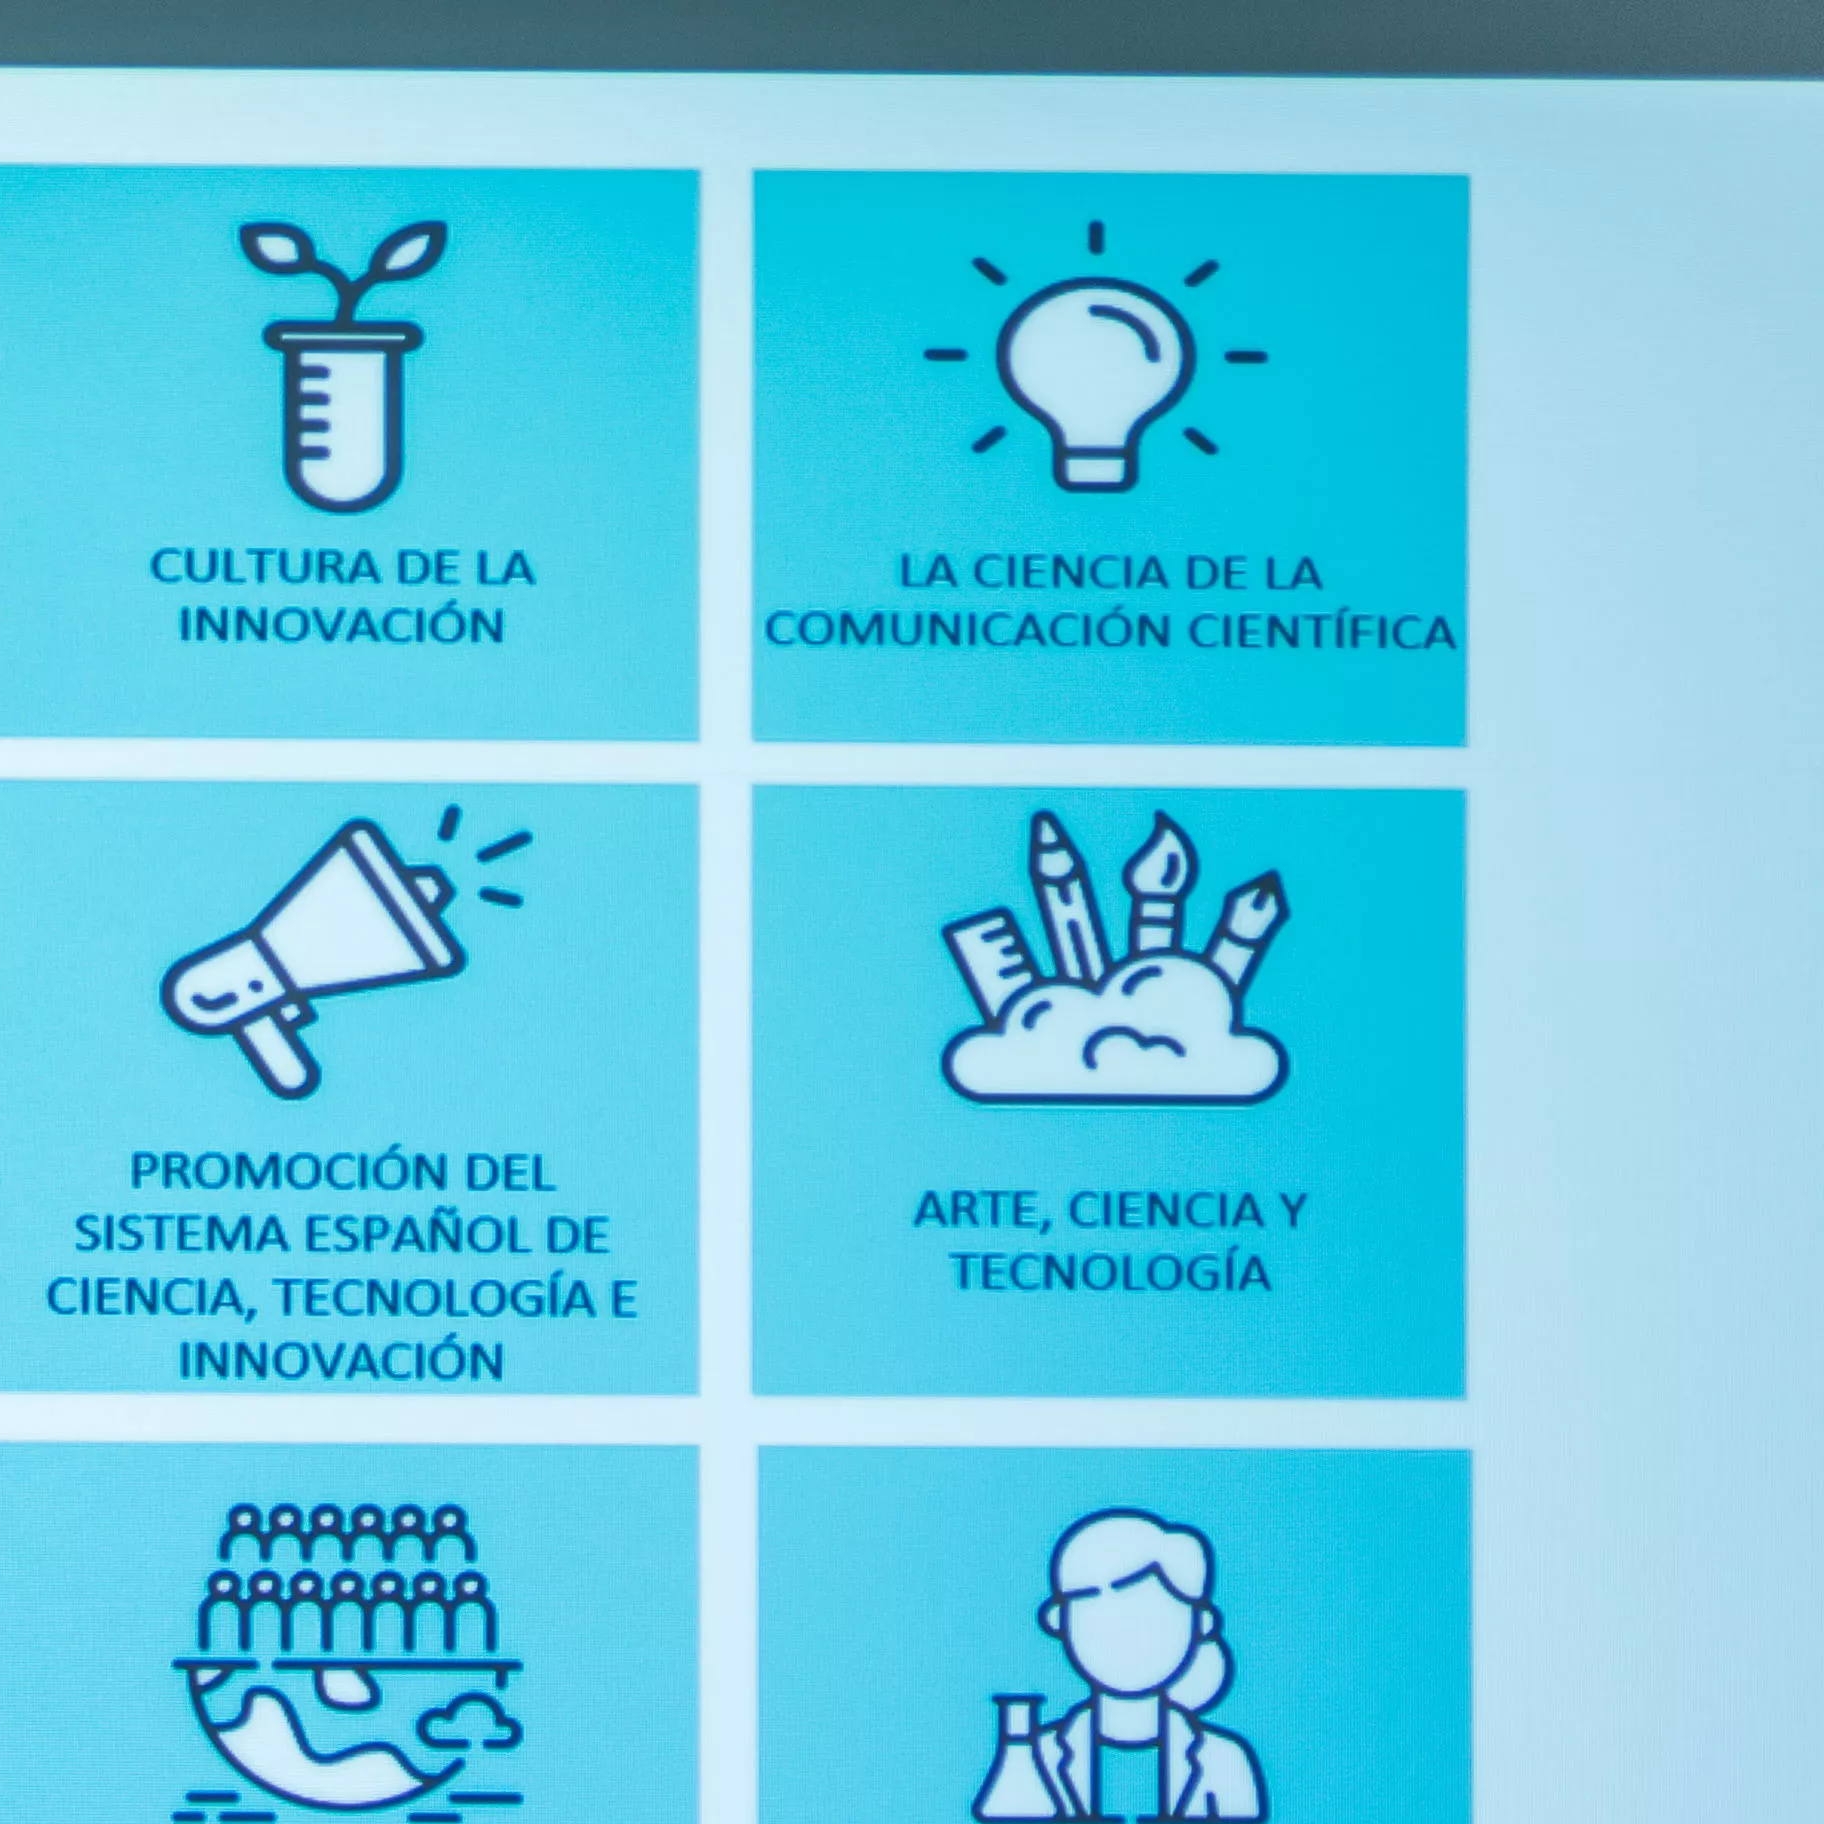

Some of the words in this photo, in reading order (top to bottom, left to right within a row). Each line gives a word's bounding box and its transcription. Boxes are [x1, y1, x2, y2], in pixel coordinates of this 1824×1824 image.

[151, 548, 381, 583] CULTURA
[398, 550, 458, 584] DE
[478, 551, 535, 584] LA
[902, 554, 958, 587] LA
[974, 554, 1169, 588] CIENCIA
[1187, 555, 1246, 589] DE
[1267, 556, 1323, 590] LA
[181, 600, 503, 643] INNOVACIÓN
[766, 605, 1170, 647] COMUNICACIÓN
[1189, 607, 1456, 649] CIENTÍFICA
[132, 1144, 447, 1190] PROMOCIÓN
[467, 1154, 555, 1191] DEL
[76, 1215, 288, 1251] SISTEMA
[306, 1206, 531, 1253] ESPAÑOL
[547, 1217, 608, 1253] DE
[914, 1190, 1050, 1234] ARTE,
[1070, 1191, 1264, 1228] CIENCIA
[1280, 1193, 1307, 1228] Y
[950, 1245, 1272, 1291] TECNOLOGÍA
[47, 1277, 257, 1322] CIENCIA,
[272, 1270, 595, 1317] TECNOLOGÍA
[612, 1280, 636, 1317] E
[181, 1332, 502, 1379] INNOVACIÓN
